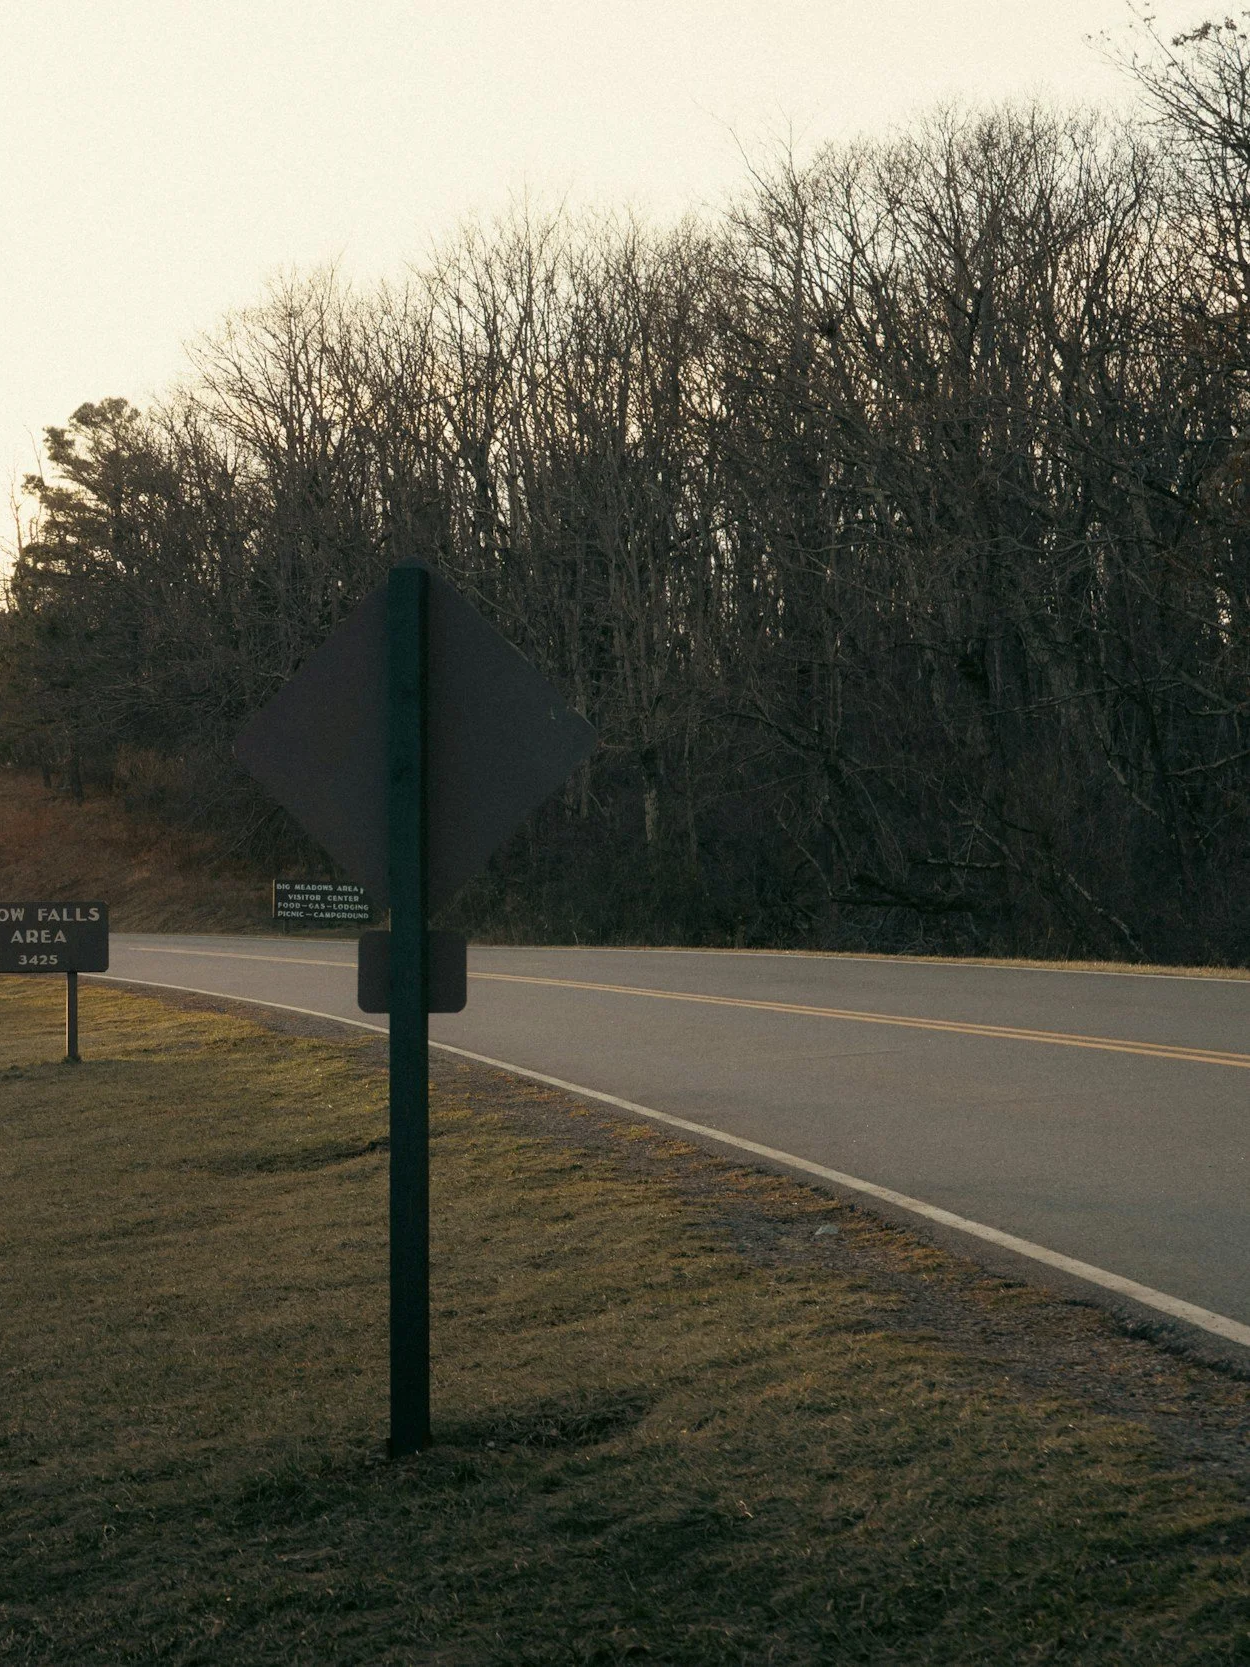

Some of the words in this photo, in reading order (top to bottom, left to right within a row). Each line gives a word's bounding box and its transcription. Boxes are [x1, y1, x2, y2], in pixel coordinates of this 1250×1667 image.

[38, 907, 100, 922] FALLS
[10, 929, 67, 943] AREA
[18, 954, 58, 965] 3425
